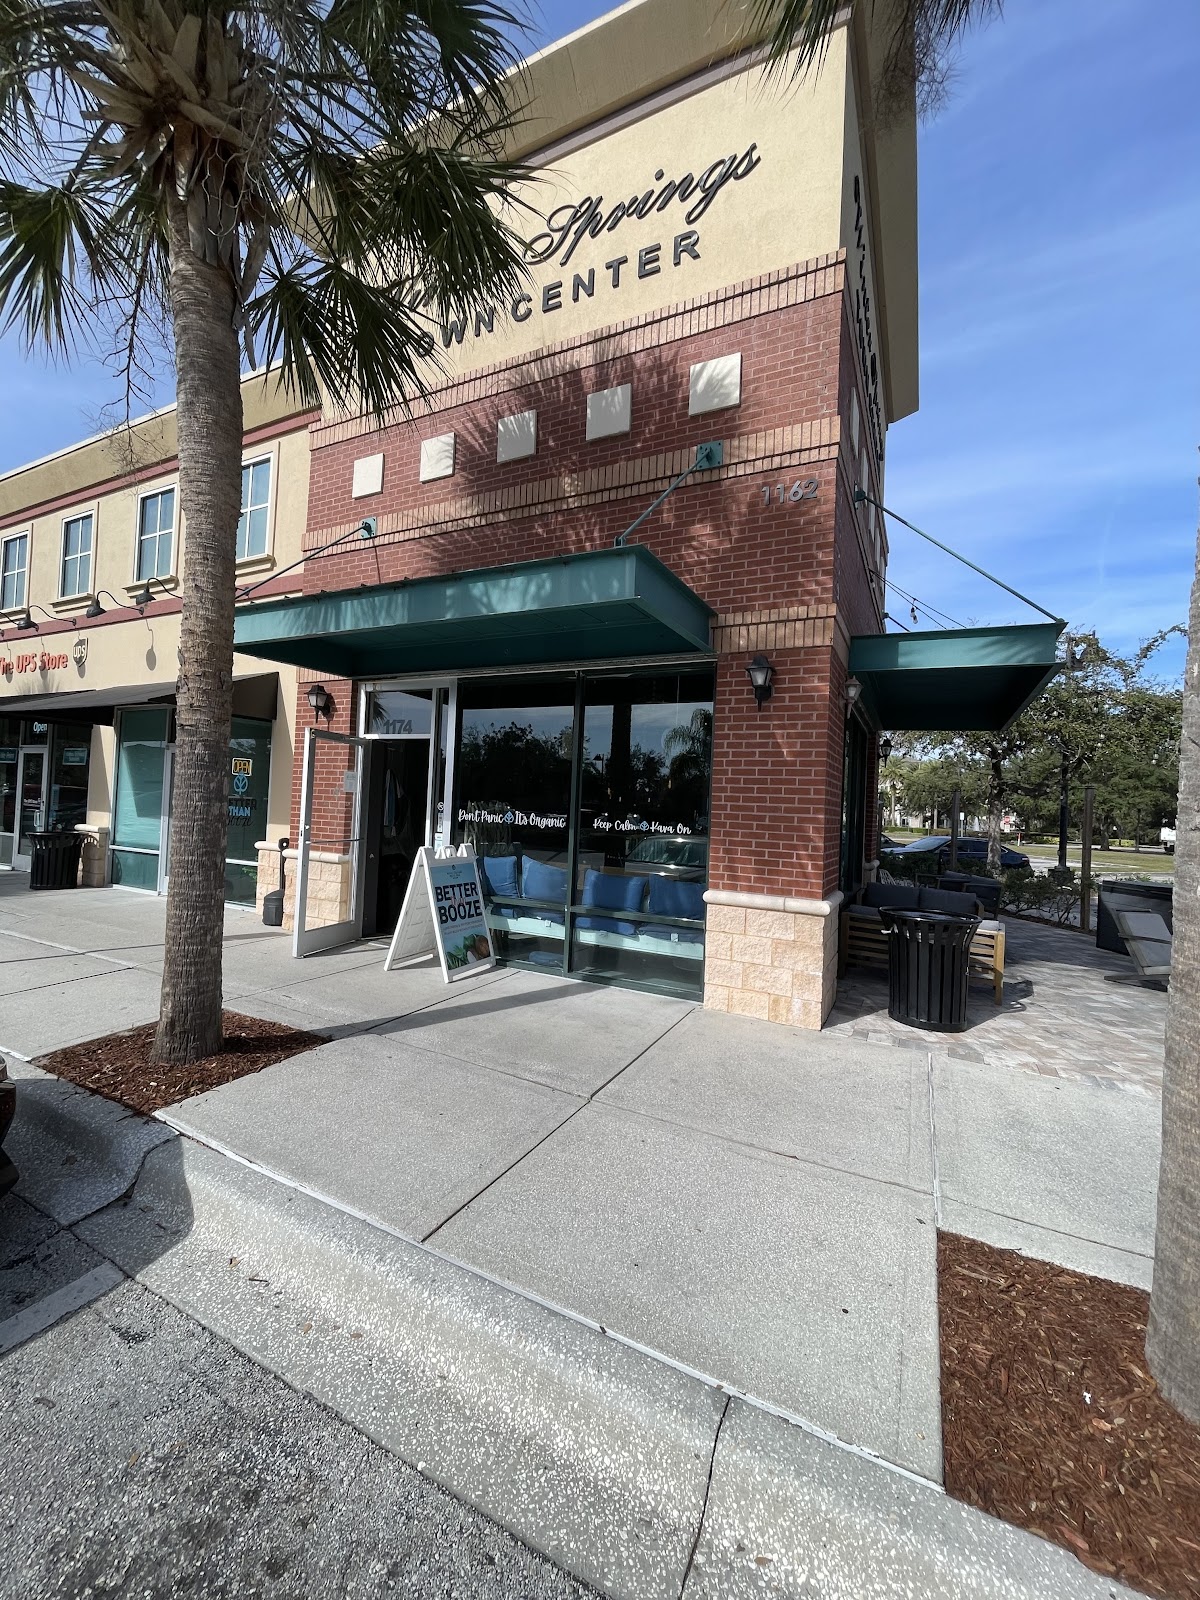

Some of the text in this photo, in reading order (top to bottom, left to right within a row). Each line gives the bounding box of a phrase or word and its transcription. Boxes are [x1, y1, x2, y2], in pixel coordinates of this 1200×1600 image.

[522, 142, 761, 267] Springs
[511, 229, 701, 322] CENTER
[761, 478, 818, 506] 1162
[15, 653, 37, 673] UPS
[38, 651, 69, 671] Store
[33, 721, 48, 734] Open
[384, 719, 413, 735] 1174
[233, 759, 251, 774] OPEN
[228, 806, 251, 817] THAN
[481, 809, 505, 824] Panic
[529, 812, 566, 829] Organic
[592, 818, 638, 831] Keep Calm
[650, 821, 692, 835] Kava On
[435, 882, 478, 903] BETTER
[438, 899, 482, 925] BOOZE
